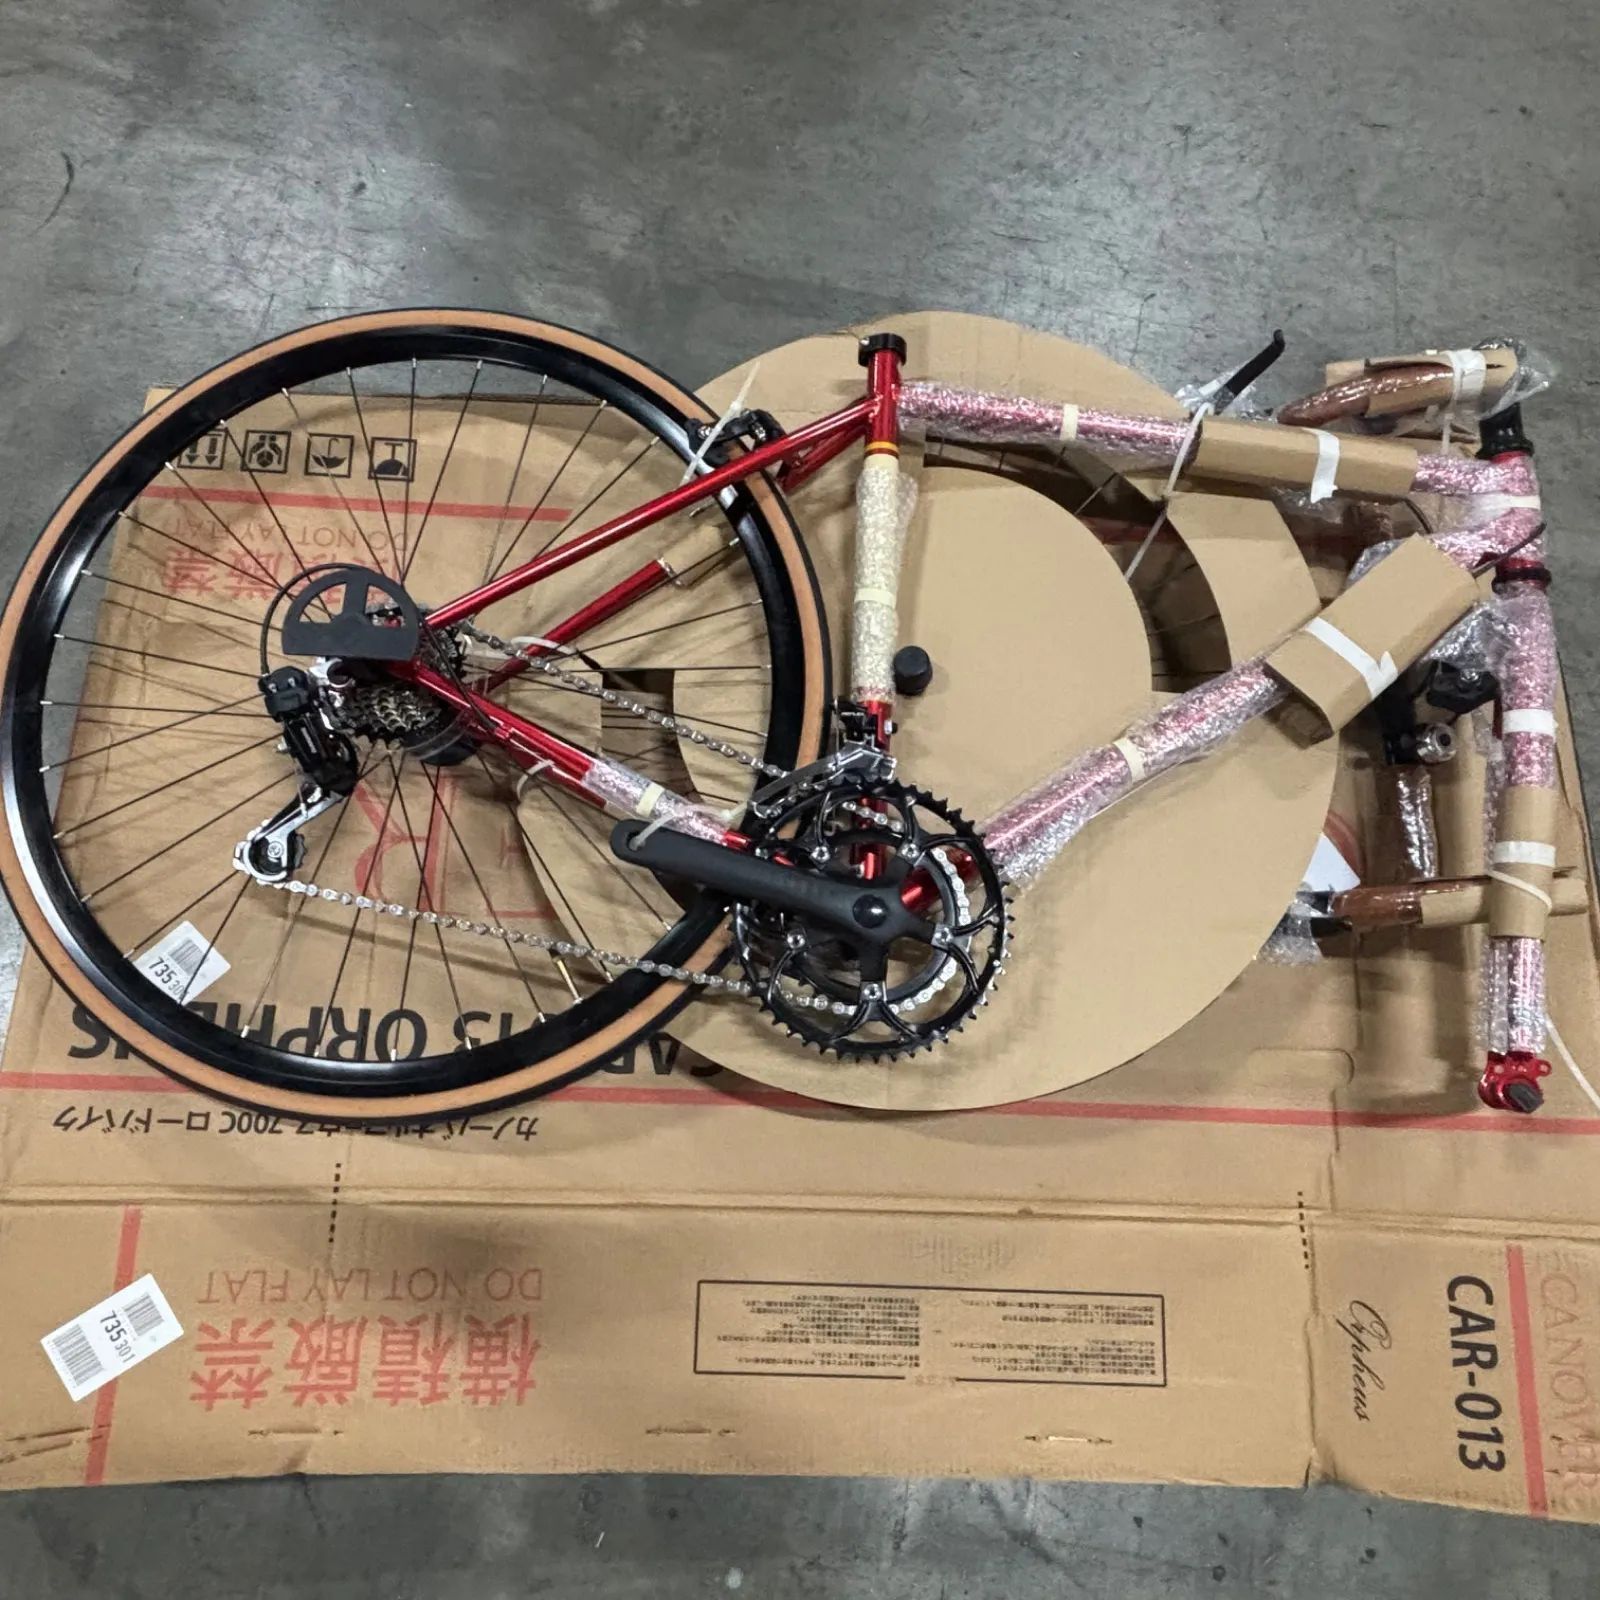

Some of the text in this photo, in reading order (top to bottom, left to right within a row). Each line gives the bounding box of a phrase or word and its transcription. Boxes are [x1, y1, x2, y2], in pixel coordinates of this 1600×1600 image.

[298, 525, 358, 549] NOT
[148, 956, 178, 984] 735
[52, 1105, 211, 1134] ロードバイク
[218, 1110, 284, 1134] 700C
[197, 1267, 543, 1304] DO NOT LAY FLAT
[99, 1309, 136, 1364] 735 301
[189, 1311, 542, 1413] 横積厳禁
[1332, 1299, 1393, 1422] Orpheus
[1446, 1274, 1507, 1473] CAR-013
